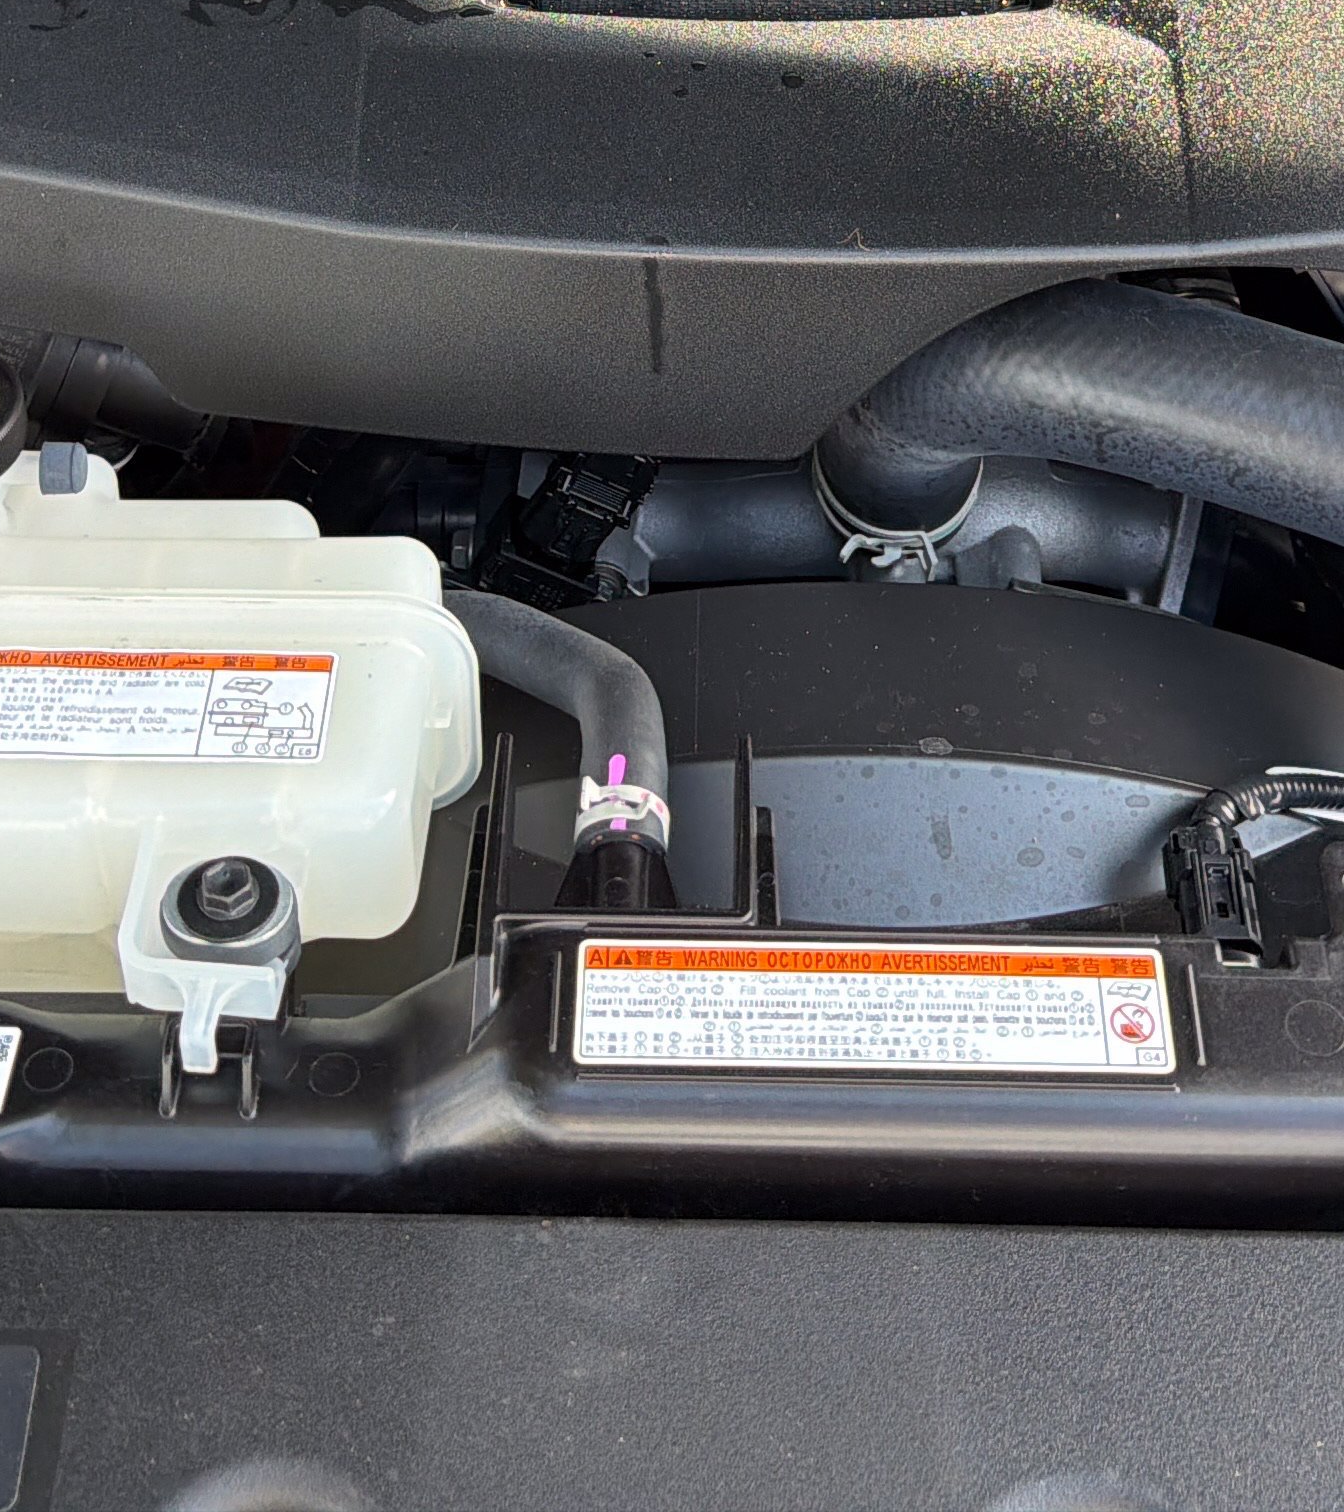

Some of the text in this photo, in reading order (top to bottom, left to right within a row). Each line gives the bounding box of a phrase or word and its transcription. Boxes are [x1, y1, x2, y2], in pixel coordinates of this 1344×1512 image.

[40, 653, 170, 667] AVERTISSEMENT
[588, 949, 604, 965] A
[683, 950, 758, 968] WARNING
[767, 951, 872, 970] ОСТОРОЖНО
[881, 953, 1010, 972] AVERTISSEMENT
[586, 983, 631, 994] Remove
[684, 984, 707, 994] and
[763, 986, 807, 997] coolant
[814, 987, 840, 997] from
[894, 988, 919, 998] until
[954, 989, 990, 1000] Install
[1044, 991, 1066, 1001] and
[1142, 1052, 1161, 1062] G4
